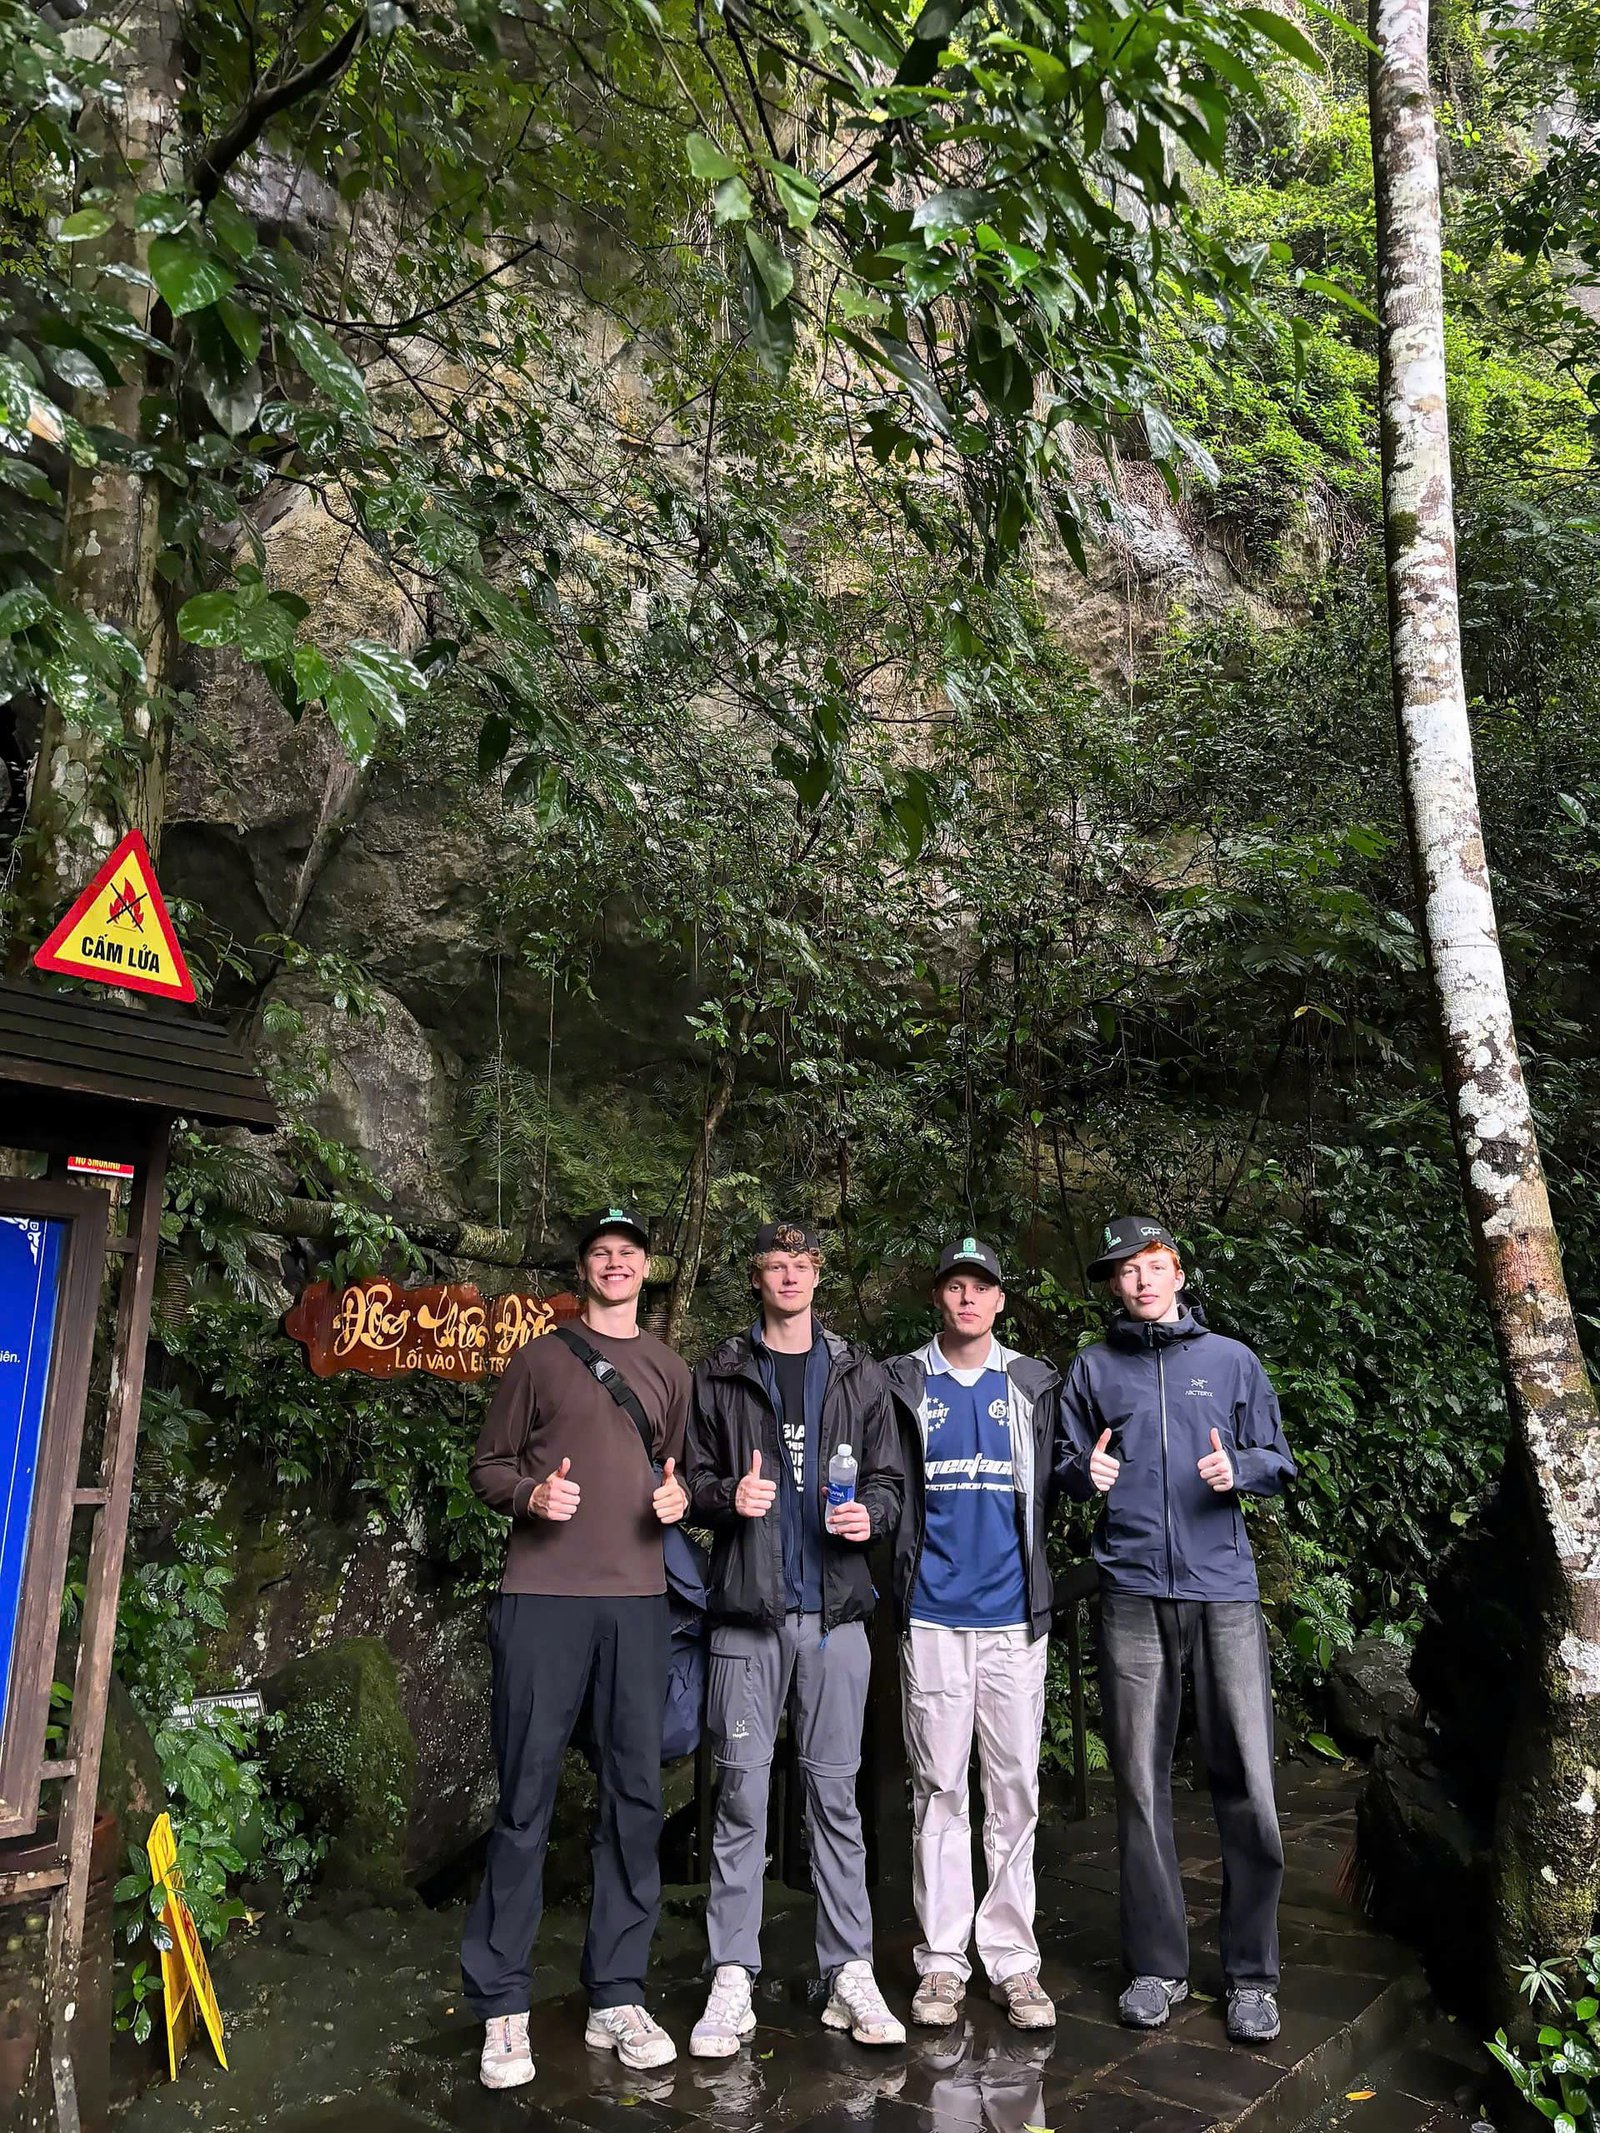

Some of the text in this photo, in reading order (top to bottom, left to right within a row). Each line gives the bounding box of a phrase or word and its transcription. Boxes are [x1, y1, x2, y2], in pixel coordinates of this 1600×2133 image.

[82, 934, 160, 973] CẤM LỬA
[395, 1346, 423, 1369] LỐI
[426, 1349, 456, 1370] VÀO
